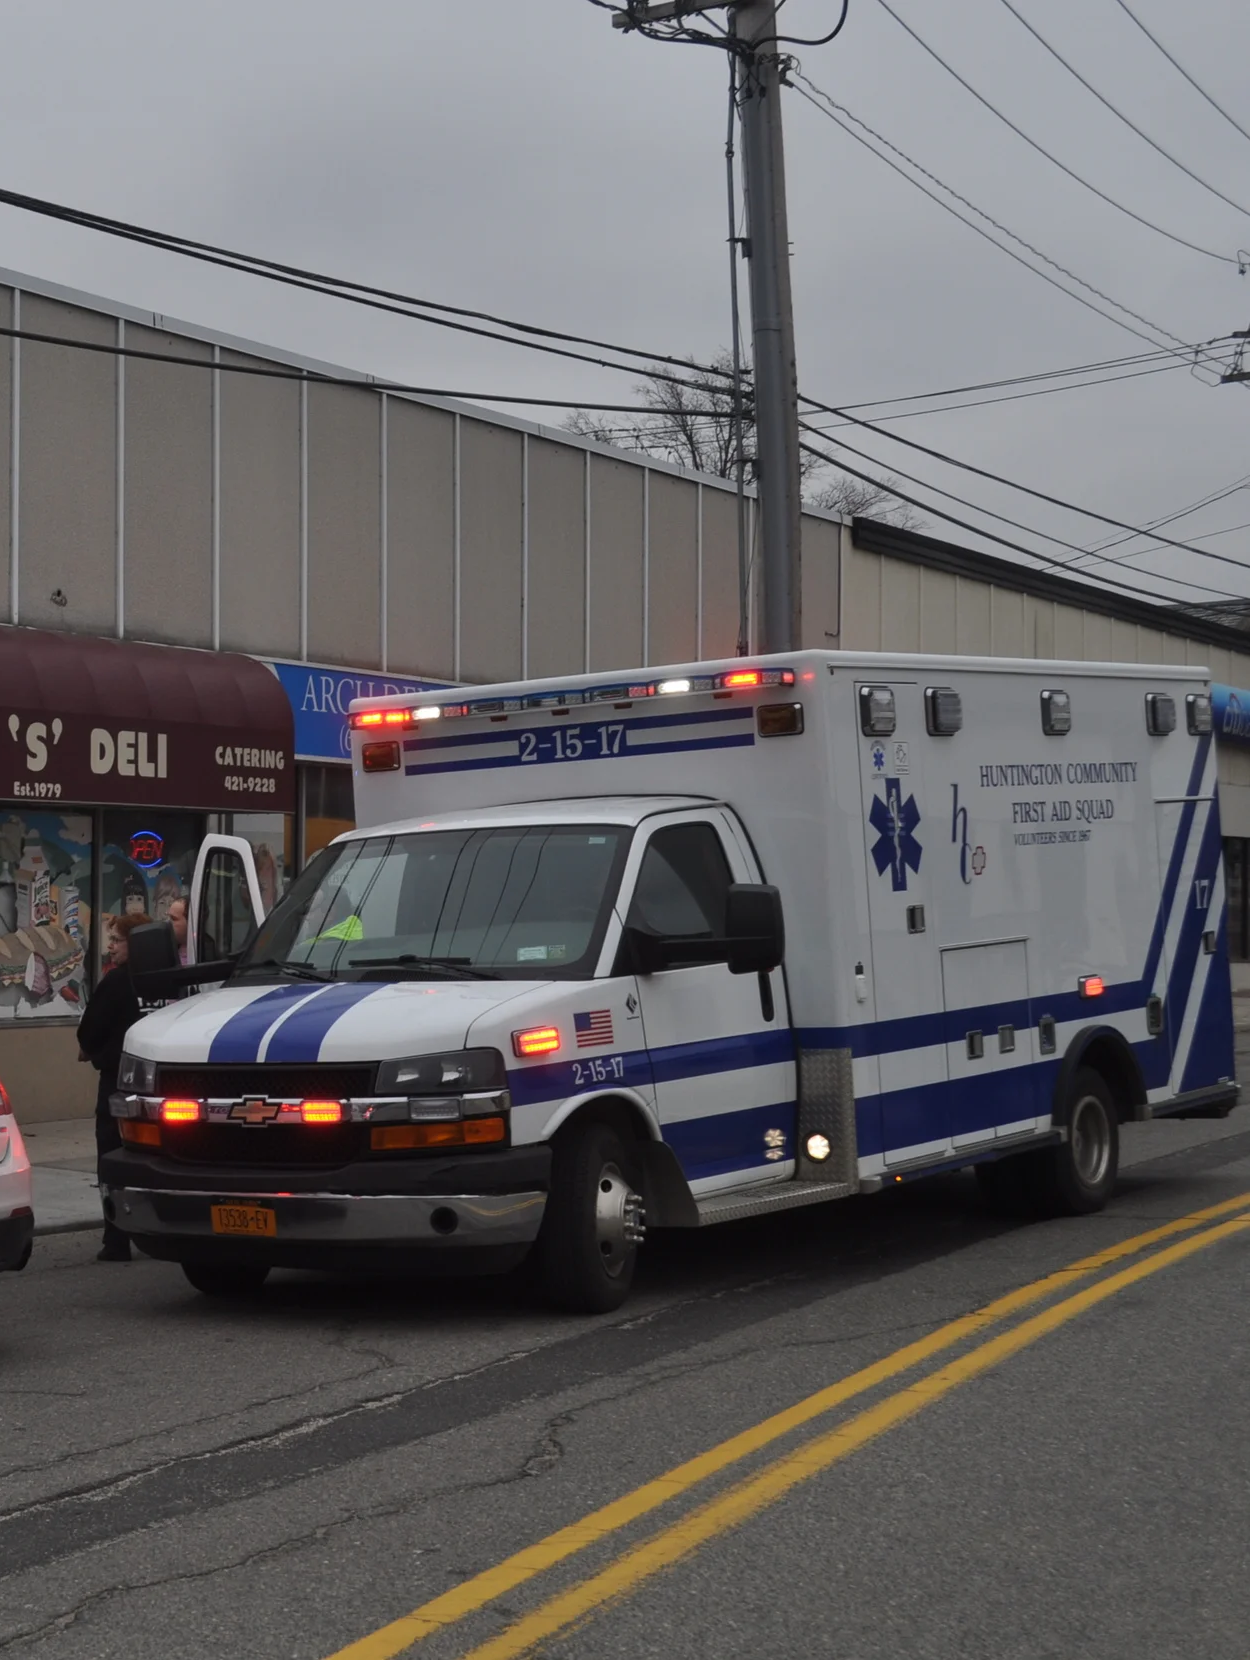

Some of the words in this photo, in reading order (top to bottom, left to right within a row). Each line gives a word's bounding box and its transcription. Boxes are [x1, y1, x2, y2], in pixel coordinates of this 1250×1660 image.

[90, 728, 168, 779] DELI
[520, 724, 625, 762] 2-15-17
[215, 746, 285, 770] CATERING
[224, 775, 276, 793] 421-9228
[979, 764, 1063, 787] HUNTINGTON
[1066, 762, 1138, 784] COMMUNITY
[1012, 801, 1046, 823] FIRST
[1051, 800, 1071, 821] AID
[1076, 799, 1114, 823] SQUAD
[1058, 830, 1077, 844] SINCE
[1194, 879, 1209, 909] 17
[572, 1056, 624, 1085] 2-15-17
